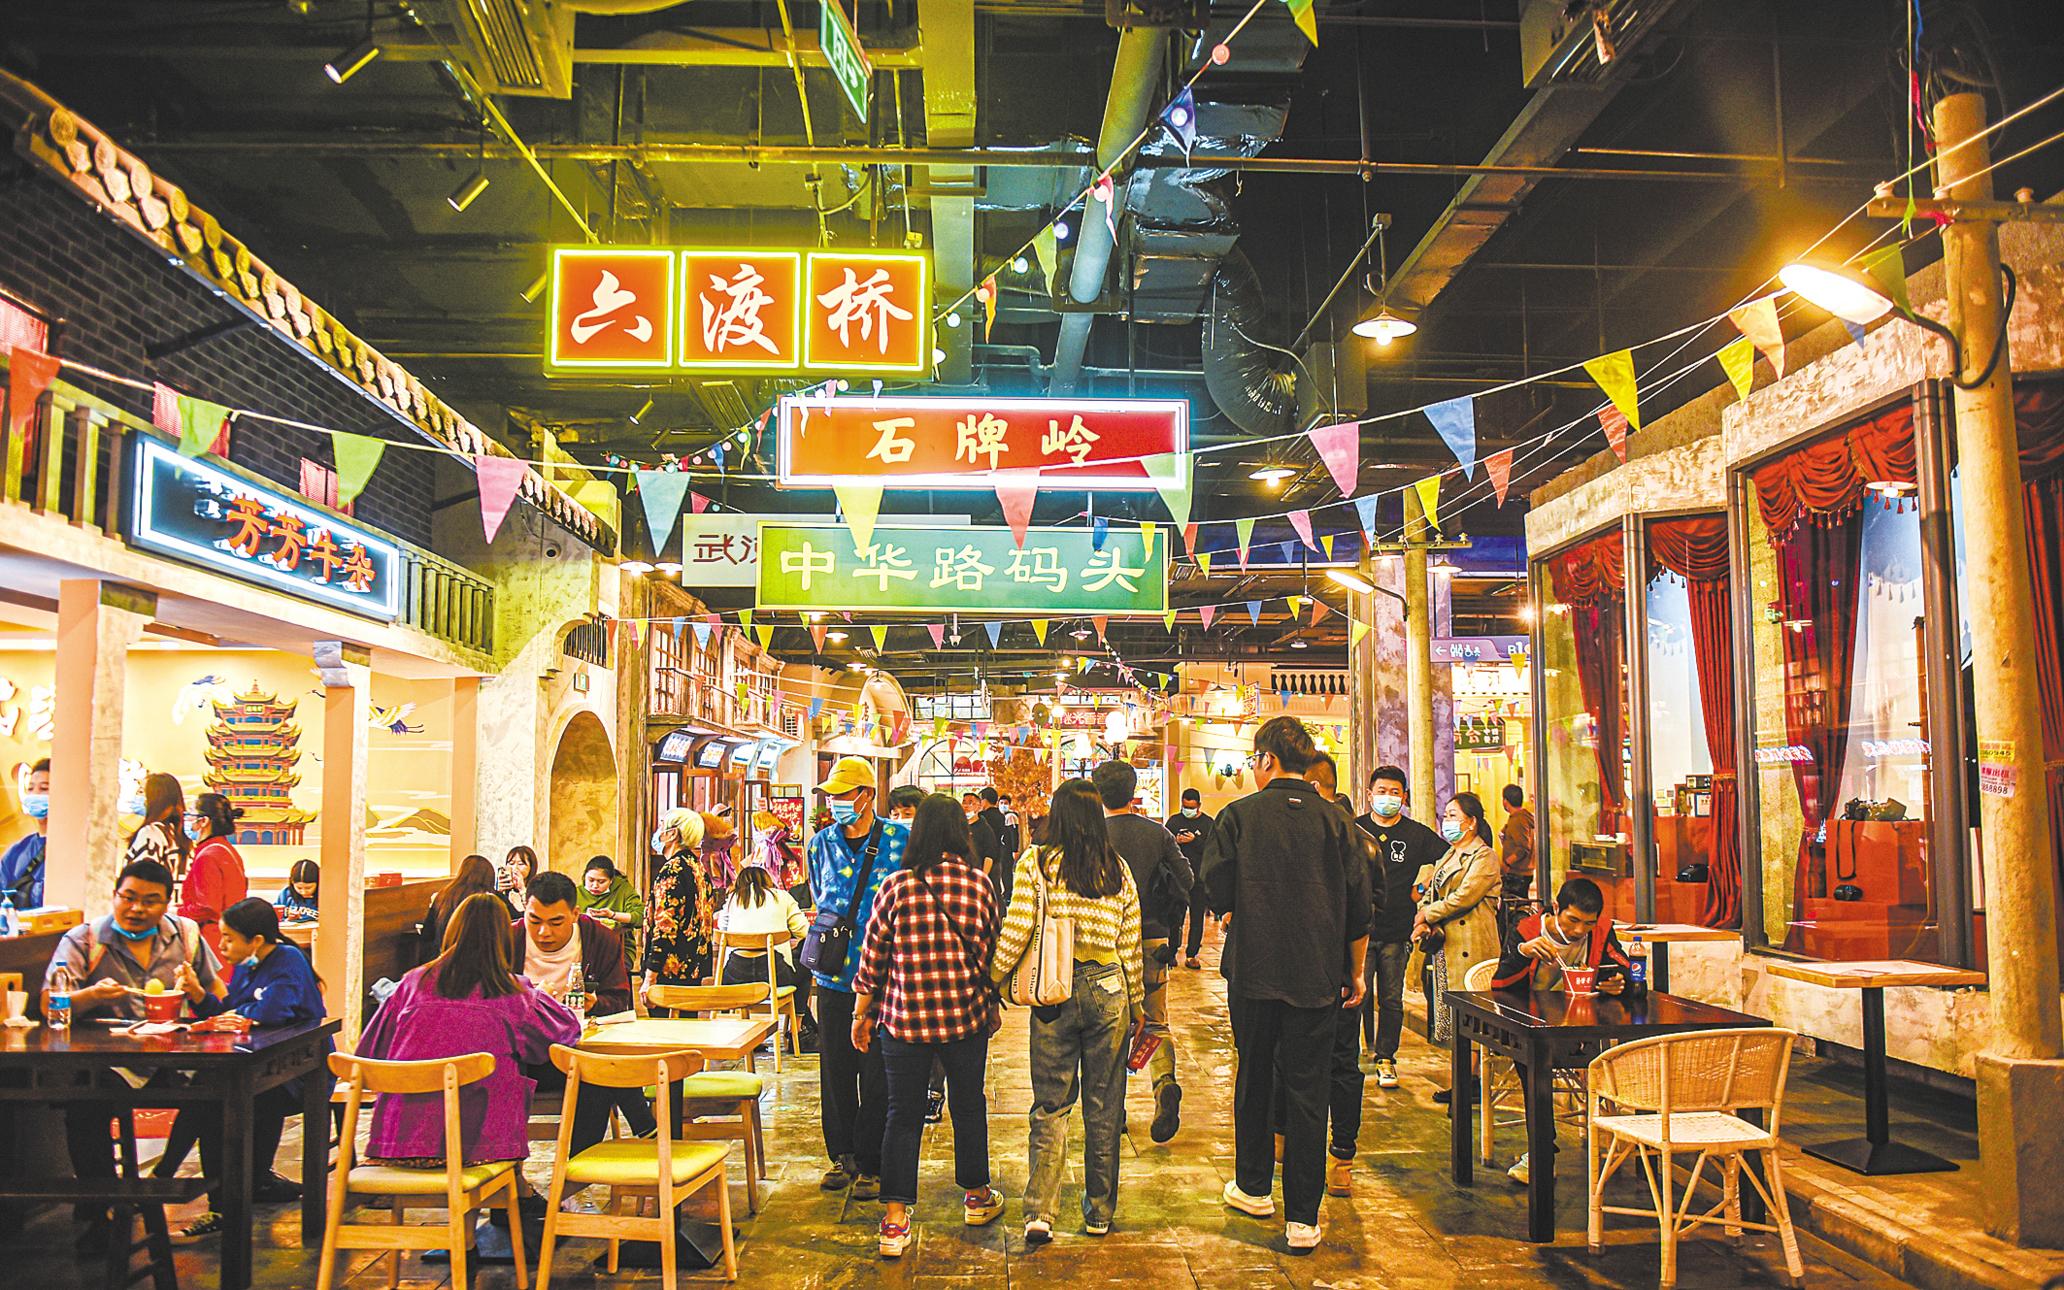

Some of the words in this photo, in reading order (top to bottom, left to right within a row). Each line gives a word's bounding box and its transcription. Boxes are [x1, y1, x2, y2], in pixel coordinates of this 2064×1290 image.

[570, 263, 913, 355] 六渡桥
[866, 412, 1102, 470] 石牌岭
[226, 492, 377, 592] 芳芳牛杂
[780, 543, 1145, 594] 中华路码头
